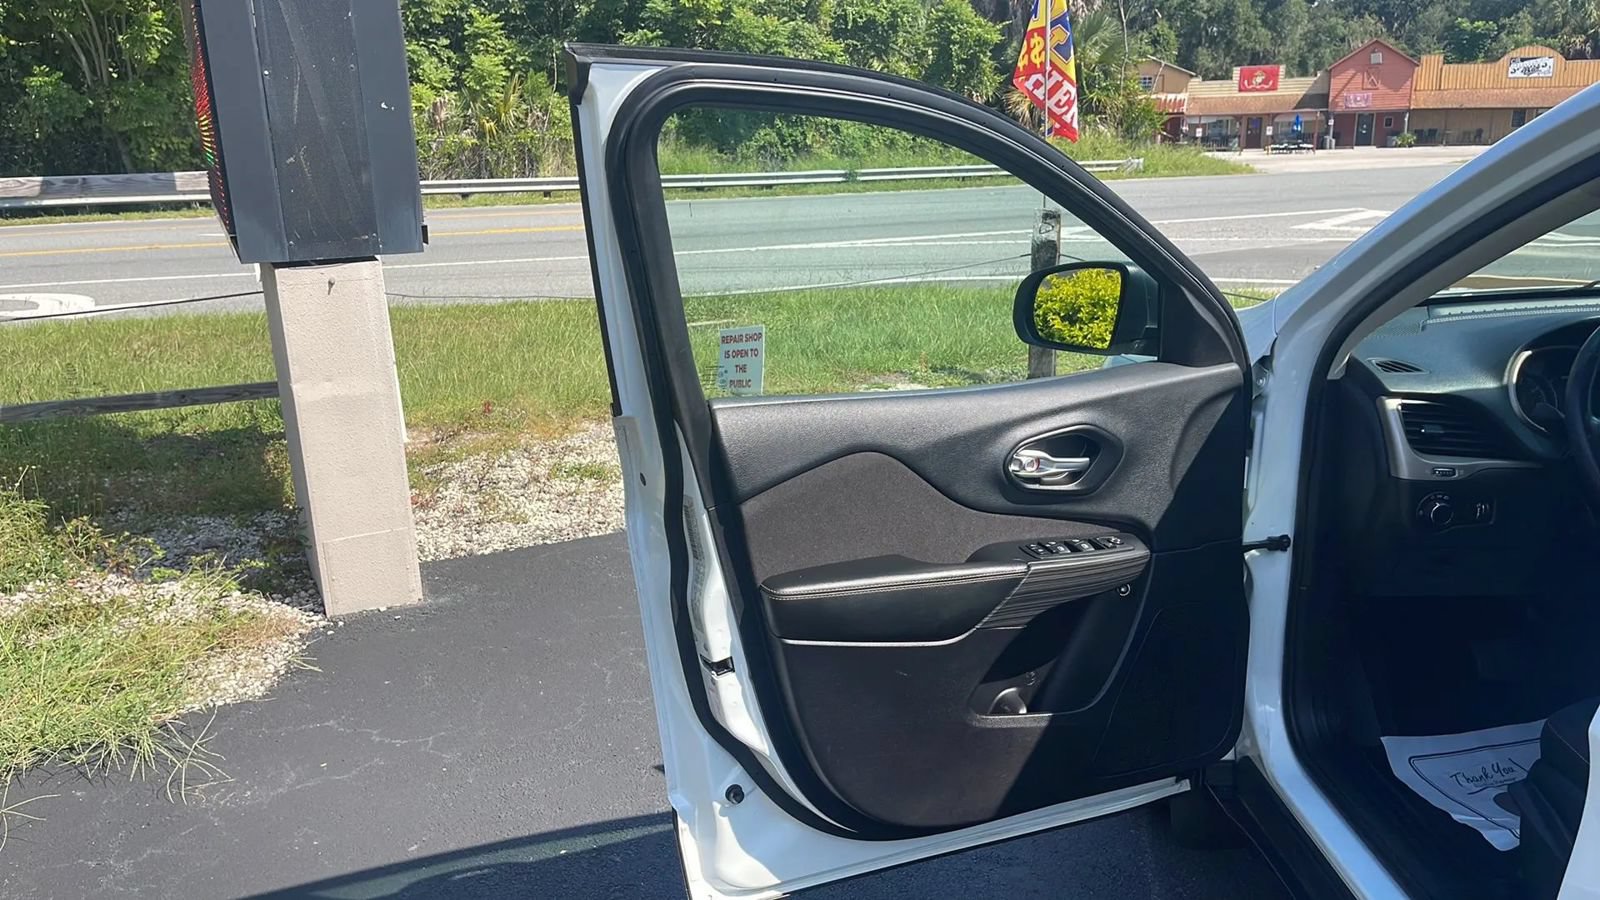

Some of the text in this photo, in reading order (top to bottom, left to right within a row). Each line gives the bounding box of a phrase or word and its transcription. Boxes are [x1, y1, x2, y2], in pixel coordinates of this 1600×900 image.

[721, 332, 762, 344] REPAIR SHOP
[724, 348, 759, 359] IS OPEN TO
[734, 364, 747, 373] THE
[729, 379, 752, 388] PUBLIC
[1449, 766, 1493, 787] Thank
[1491, 762, 1514, 777] You
